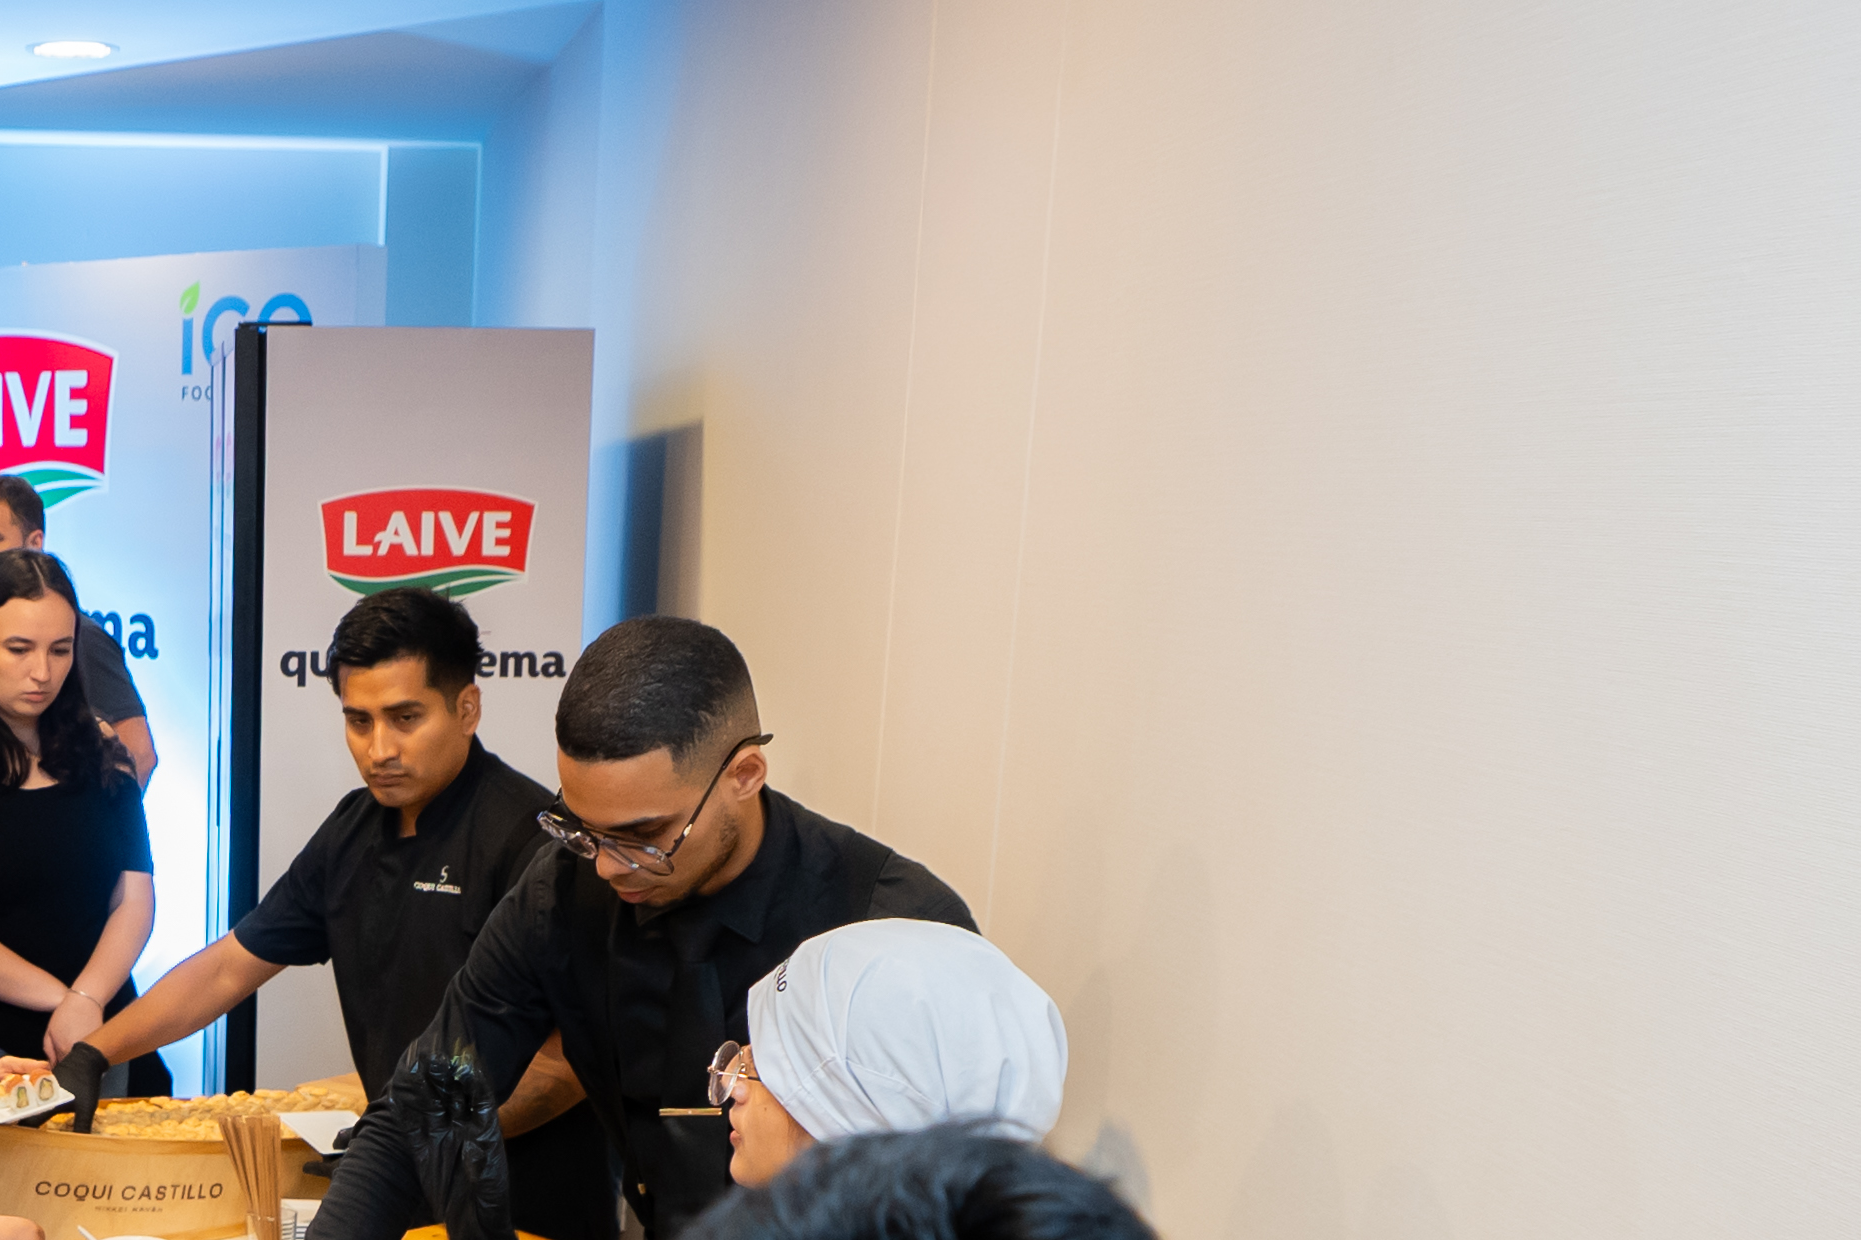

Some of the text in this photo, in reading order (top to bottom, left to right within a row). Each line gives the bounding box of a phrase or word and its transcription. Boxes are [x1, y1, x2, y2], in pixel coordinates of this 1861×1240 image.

[342, 510, 513, 558] LAIVE
[474, 650, 567, 679] ema
[35, 1181, 224, 1202] COQUI CASTILLO
